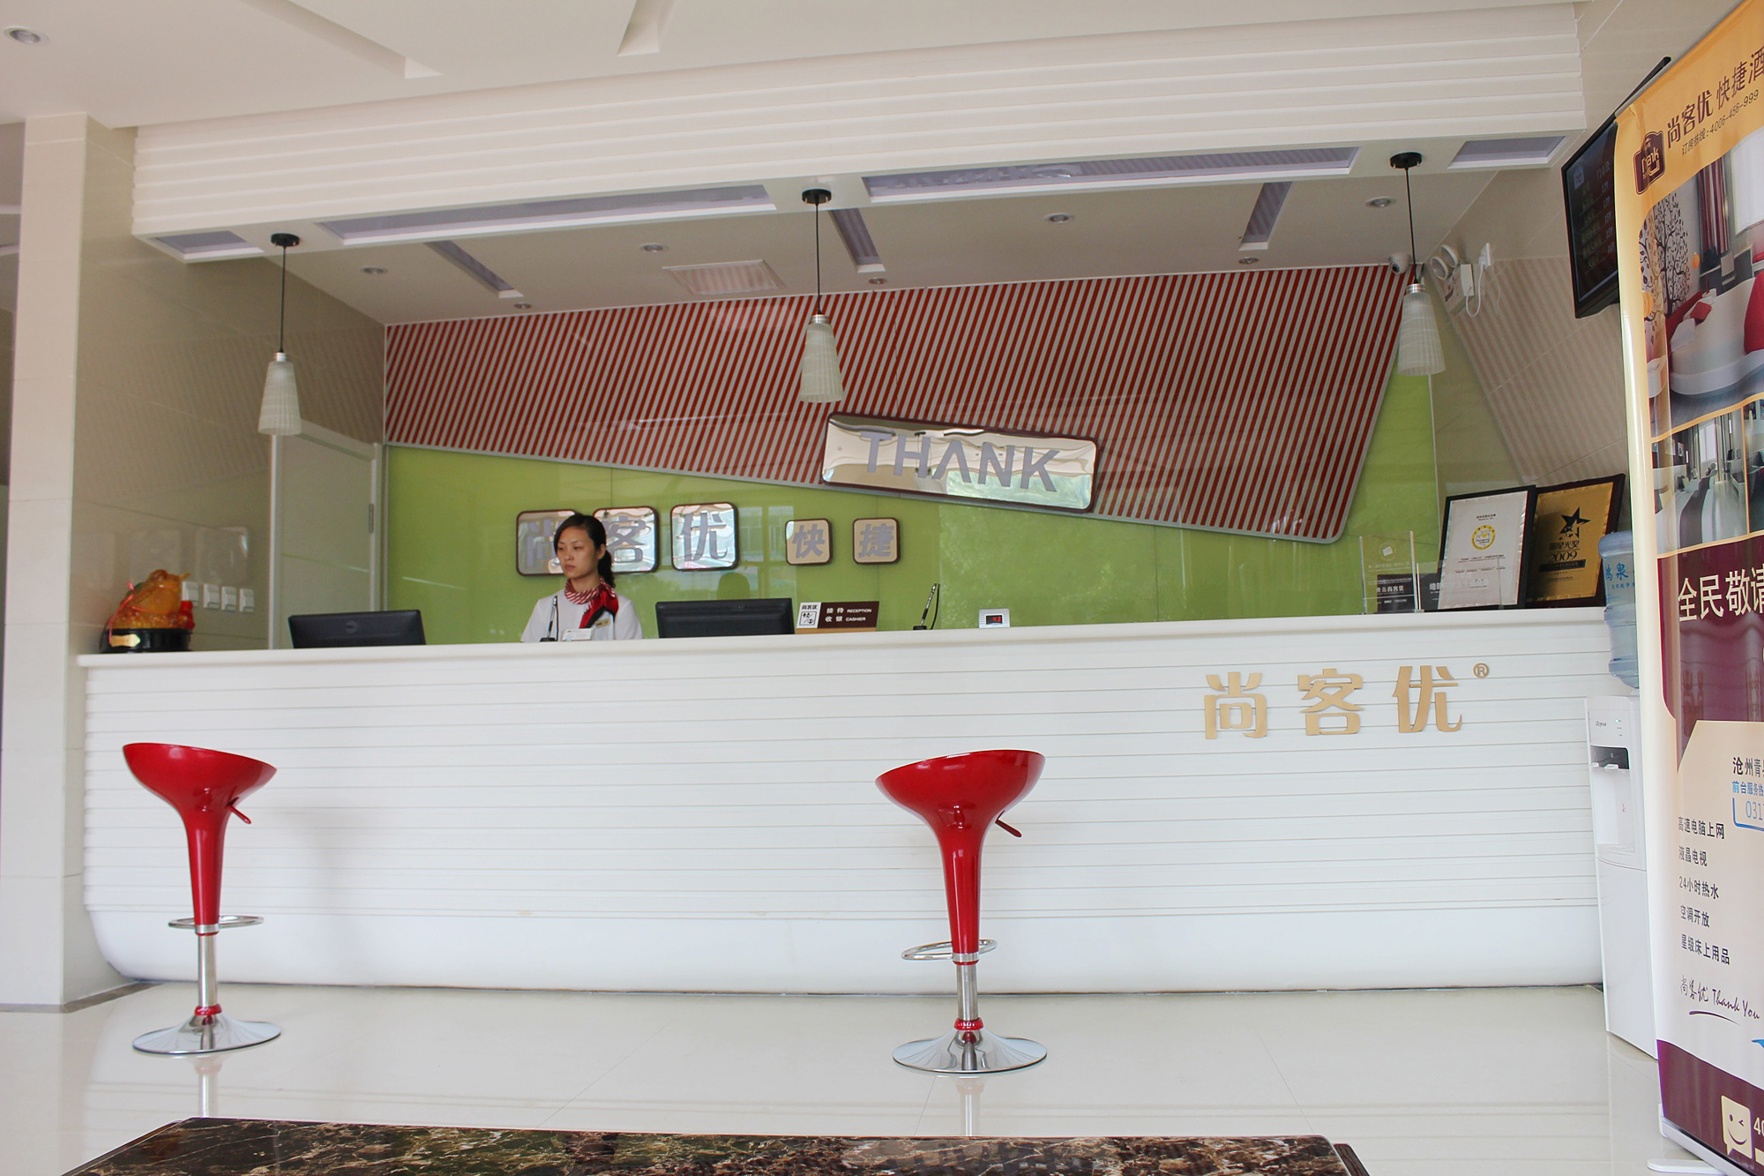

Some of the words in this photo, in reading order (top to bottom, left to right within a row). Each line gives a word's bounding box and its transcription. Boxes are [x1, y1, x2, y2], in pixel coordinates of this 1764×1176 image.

[1667, 89, 1714, 148] 尚客优
[860, 431, 1060, 493] THANK
[792, 523, 895, 559] 快捷
[1203, 665, 1463, 740] 尚客优
[1732, 756, 1764, 777] 沧州青
[1745, 800, 1764, 821] 031
[1678, 816, 1725, 840] 高速电脑上网
[1679, 845, 1707, 867] 液晶电视
[1679, 875, 1719, 900] 24小时热水
[1680, 905, 1710, 928] 空调开放
[1681, 933, 1730, 966] 星级床上用品
[1712, 988, 1740, 1013] Thank
[1742, 999, 1760, 1020] You
